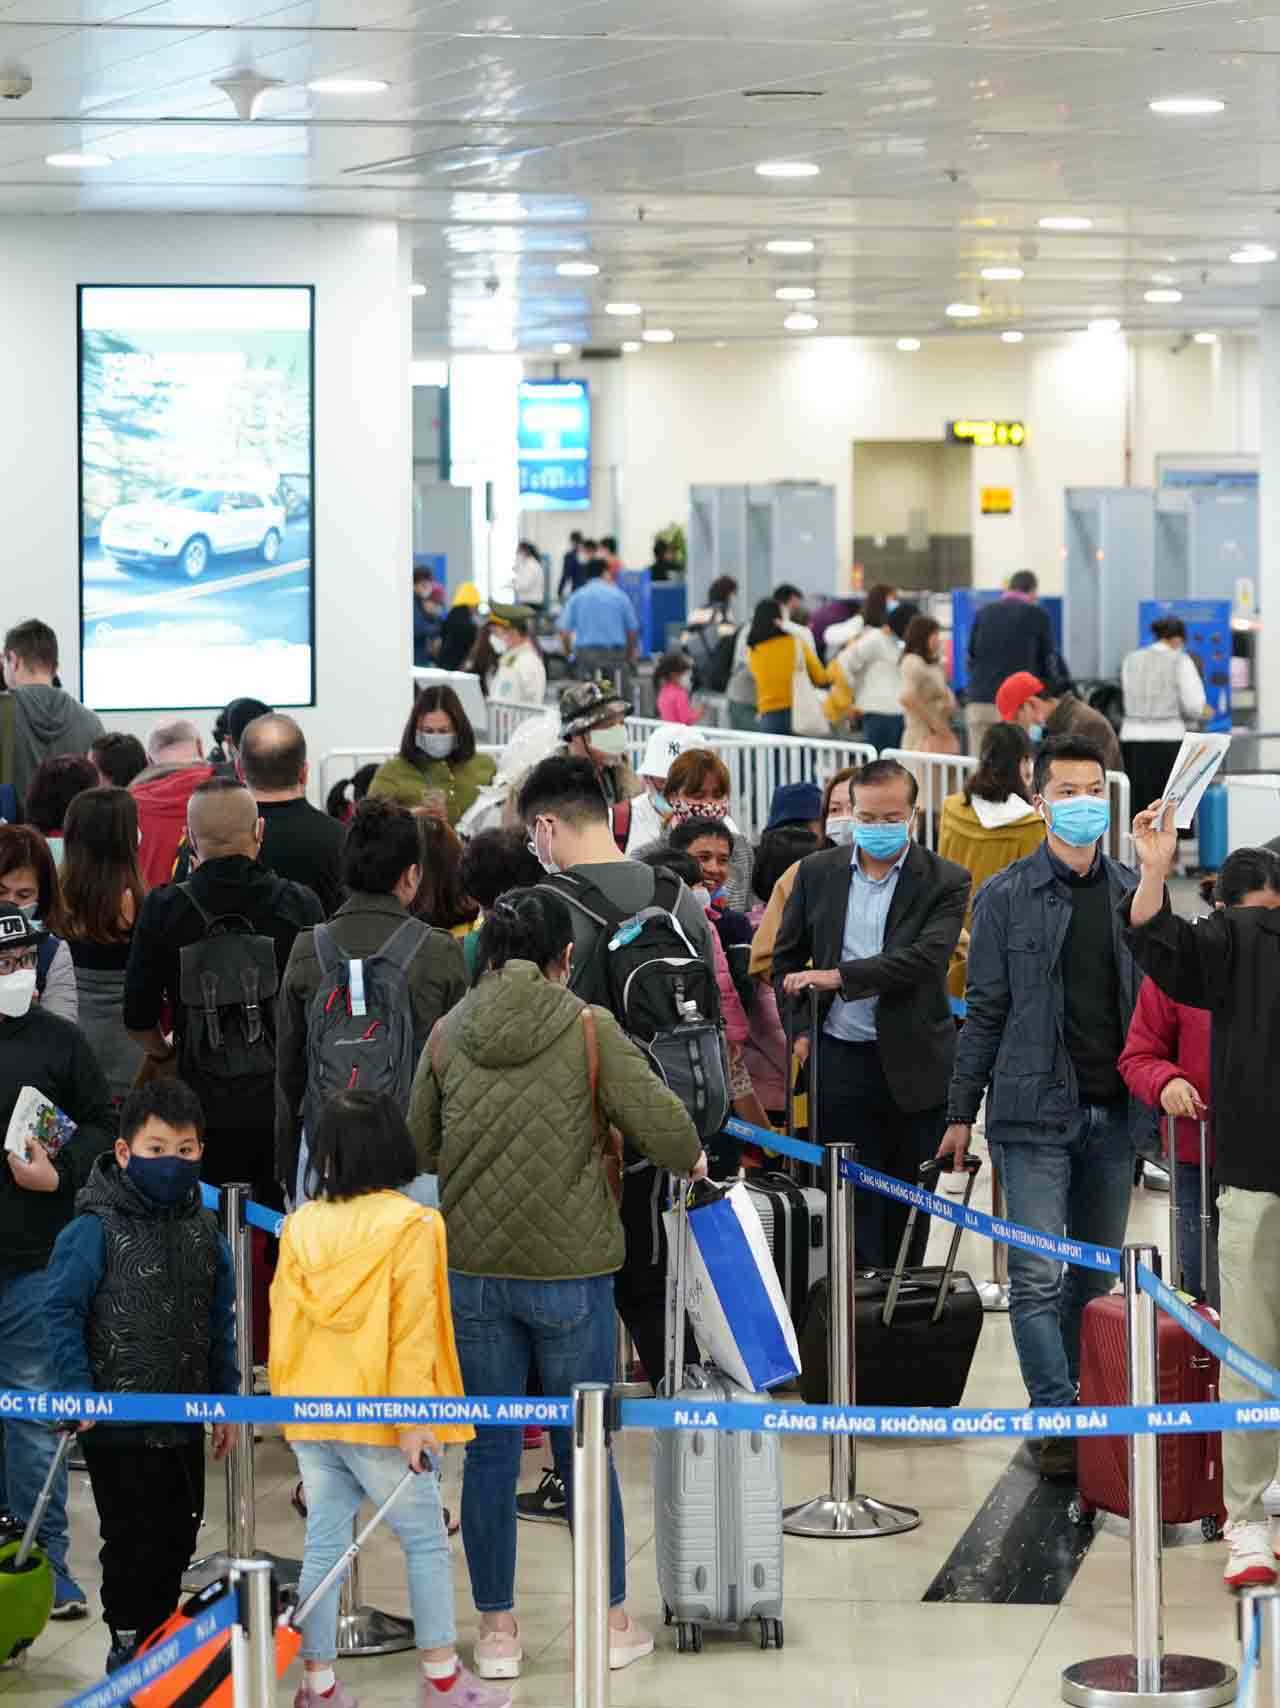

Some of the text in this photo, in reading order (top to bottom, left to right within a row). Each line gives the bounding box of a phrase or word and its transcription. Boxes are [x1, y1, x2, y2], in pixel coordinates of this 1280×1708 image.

[1011, 1228, 1057, 1253] INTERNATIONAL
[1057, 1244, 1082, 1259] AIRPORT
[27, 1393, 48, 1413] TẾ
[51, 1398, 81, 1416] NỘI
[85, 1396, 113, 1416] BÀI
[184, 1401, 226, 1418] N.I.A
[293, 1402, 352, 1419] NOIBAI
[356, 1403, 492, 1420] INTERNATIONAL
[496, 1404, 570, 1421] AIRPORT
[674, 1410, 719, 1427] N.I.A
[763, 1410, 818, 1432] CẢNG
[822, 1412, 877, 1433] HÀNG
[880, 1412, 948, 1434] KHÔNG
[950, 1410, 1006, 1433] QUỐC
[1010, 1410, 1034, 1433] TẾ
[1038, 1410, 1070, 1434] NỘI
[1075, 1410, 1108, 1429] BÀI
[1146, 1411, 1192, 1427] N.I.A
